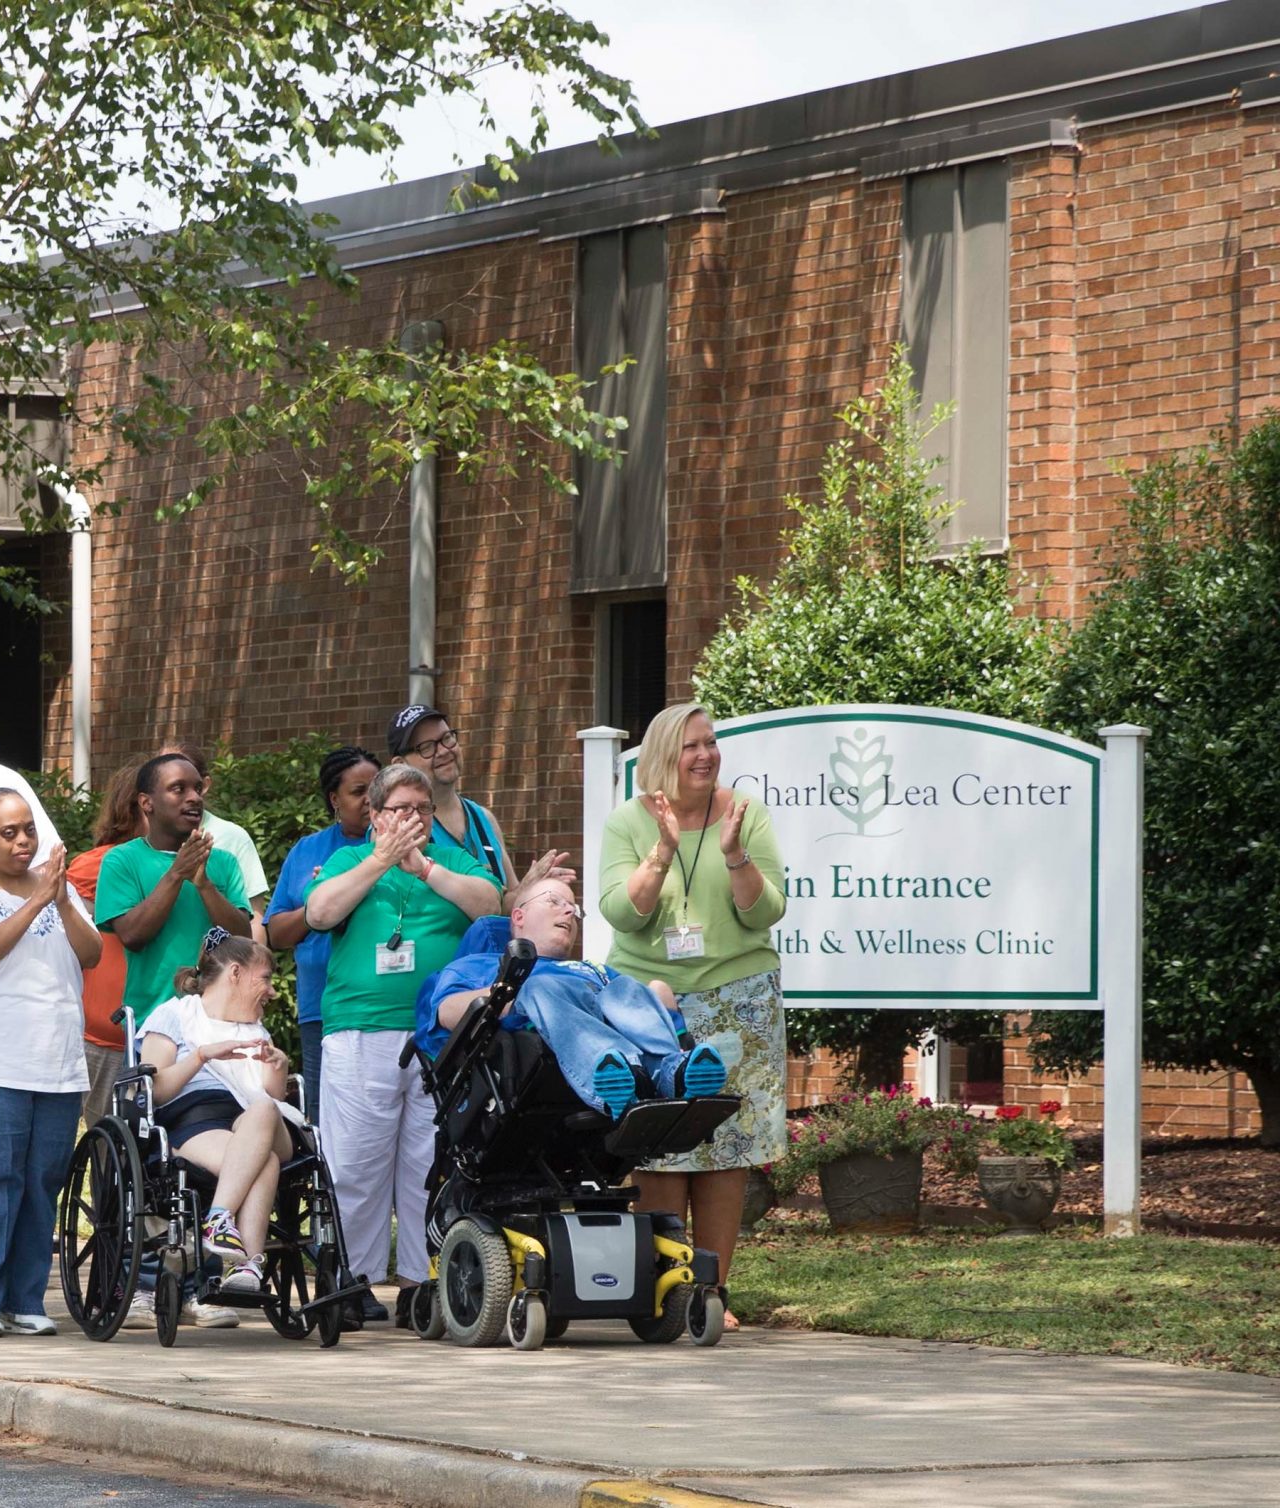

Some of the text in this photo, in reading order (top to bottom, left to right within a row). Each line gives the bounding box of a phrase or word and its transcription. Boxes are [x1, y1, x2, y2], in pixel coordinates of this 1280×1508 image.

[881, 774, 939, 807] Lea
[952, 773, 1073, 807] Center
[829, 864, 992, 899] Entrance
[819, 929, 847, 955] &
[855, 928, 967, 955] Wellness
[975, 928, 1055, 955] Clinic
